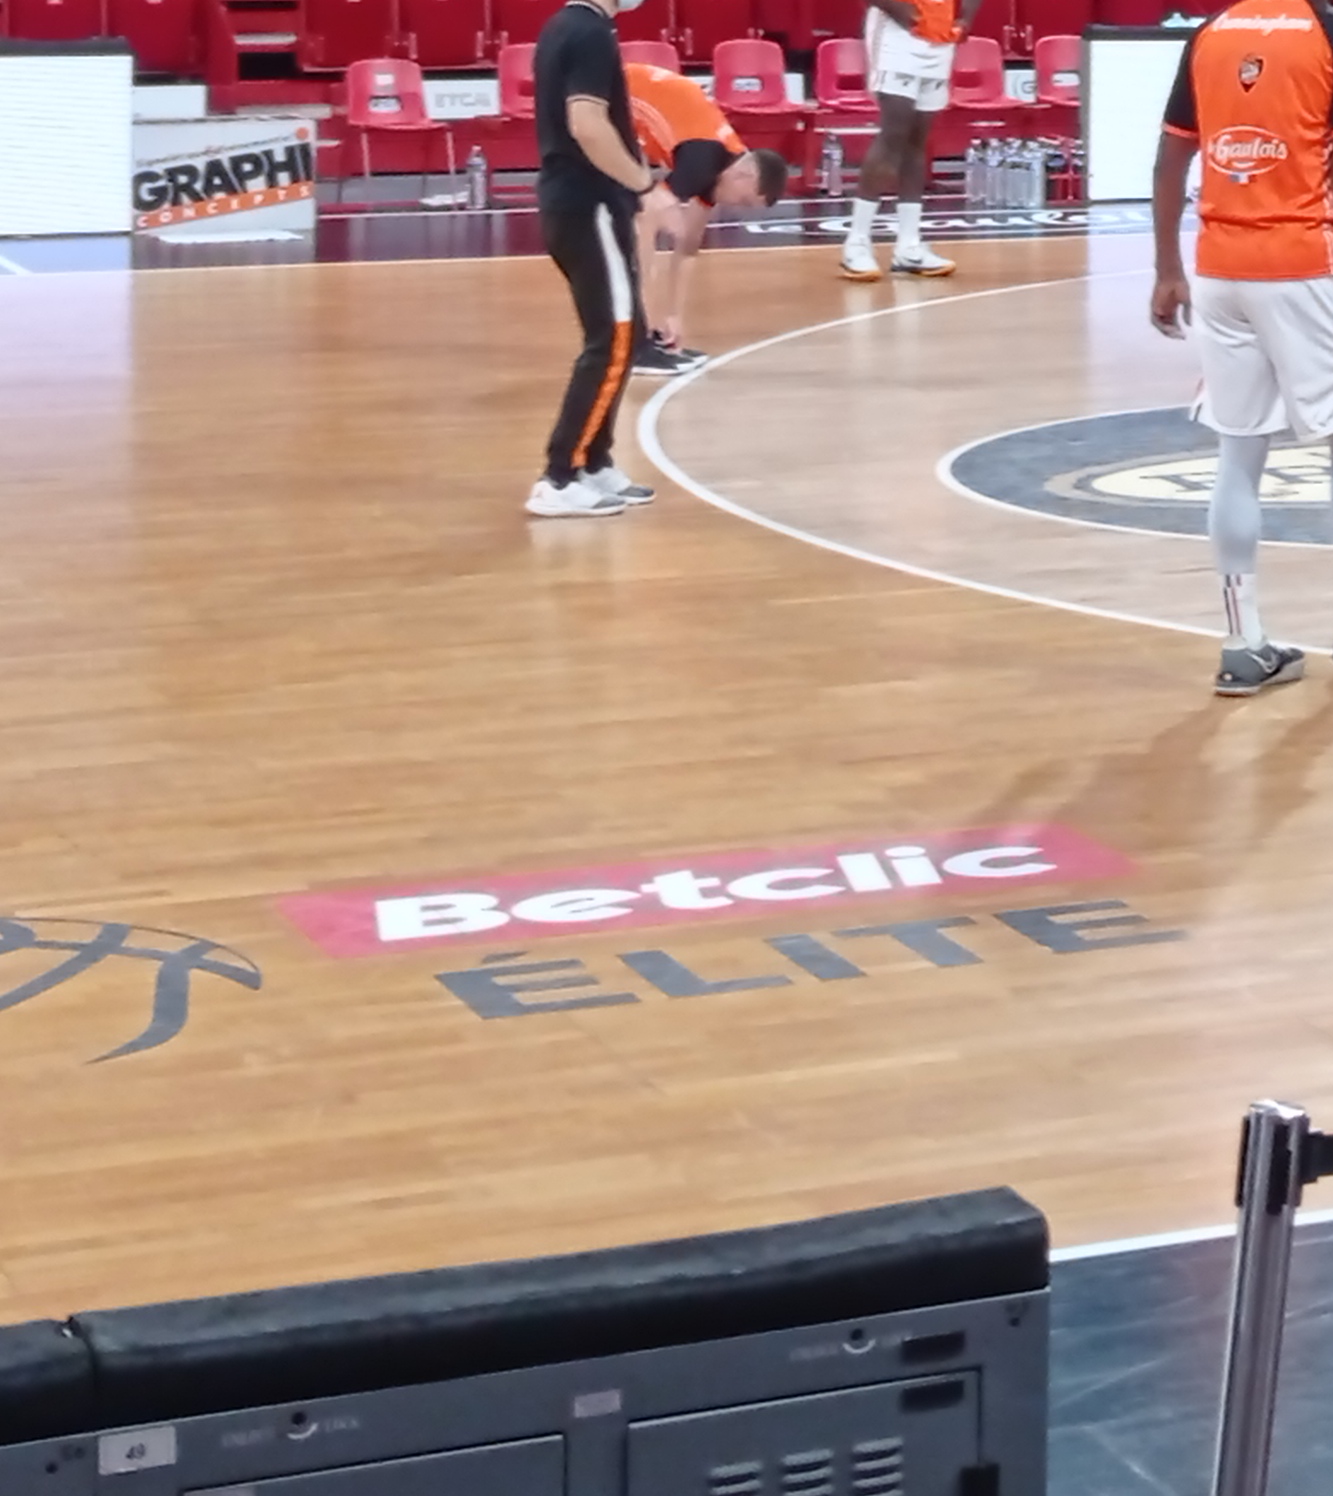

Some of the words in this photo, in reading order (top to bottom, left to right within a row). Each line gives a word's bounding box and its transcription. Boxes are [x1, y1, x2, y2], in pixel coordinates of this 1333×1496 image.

[132, 142, 313, 213] GRAPHI
[1215, 134, 1289, 166] Gaulois
[137, 184, 312, 228] CONCEPTS
[372, 840, 1058, 944] Betclic
[433, 898, 1190, 1021] ÉLITE
